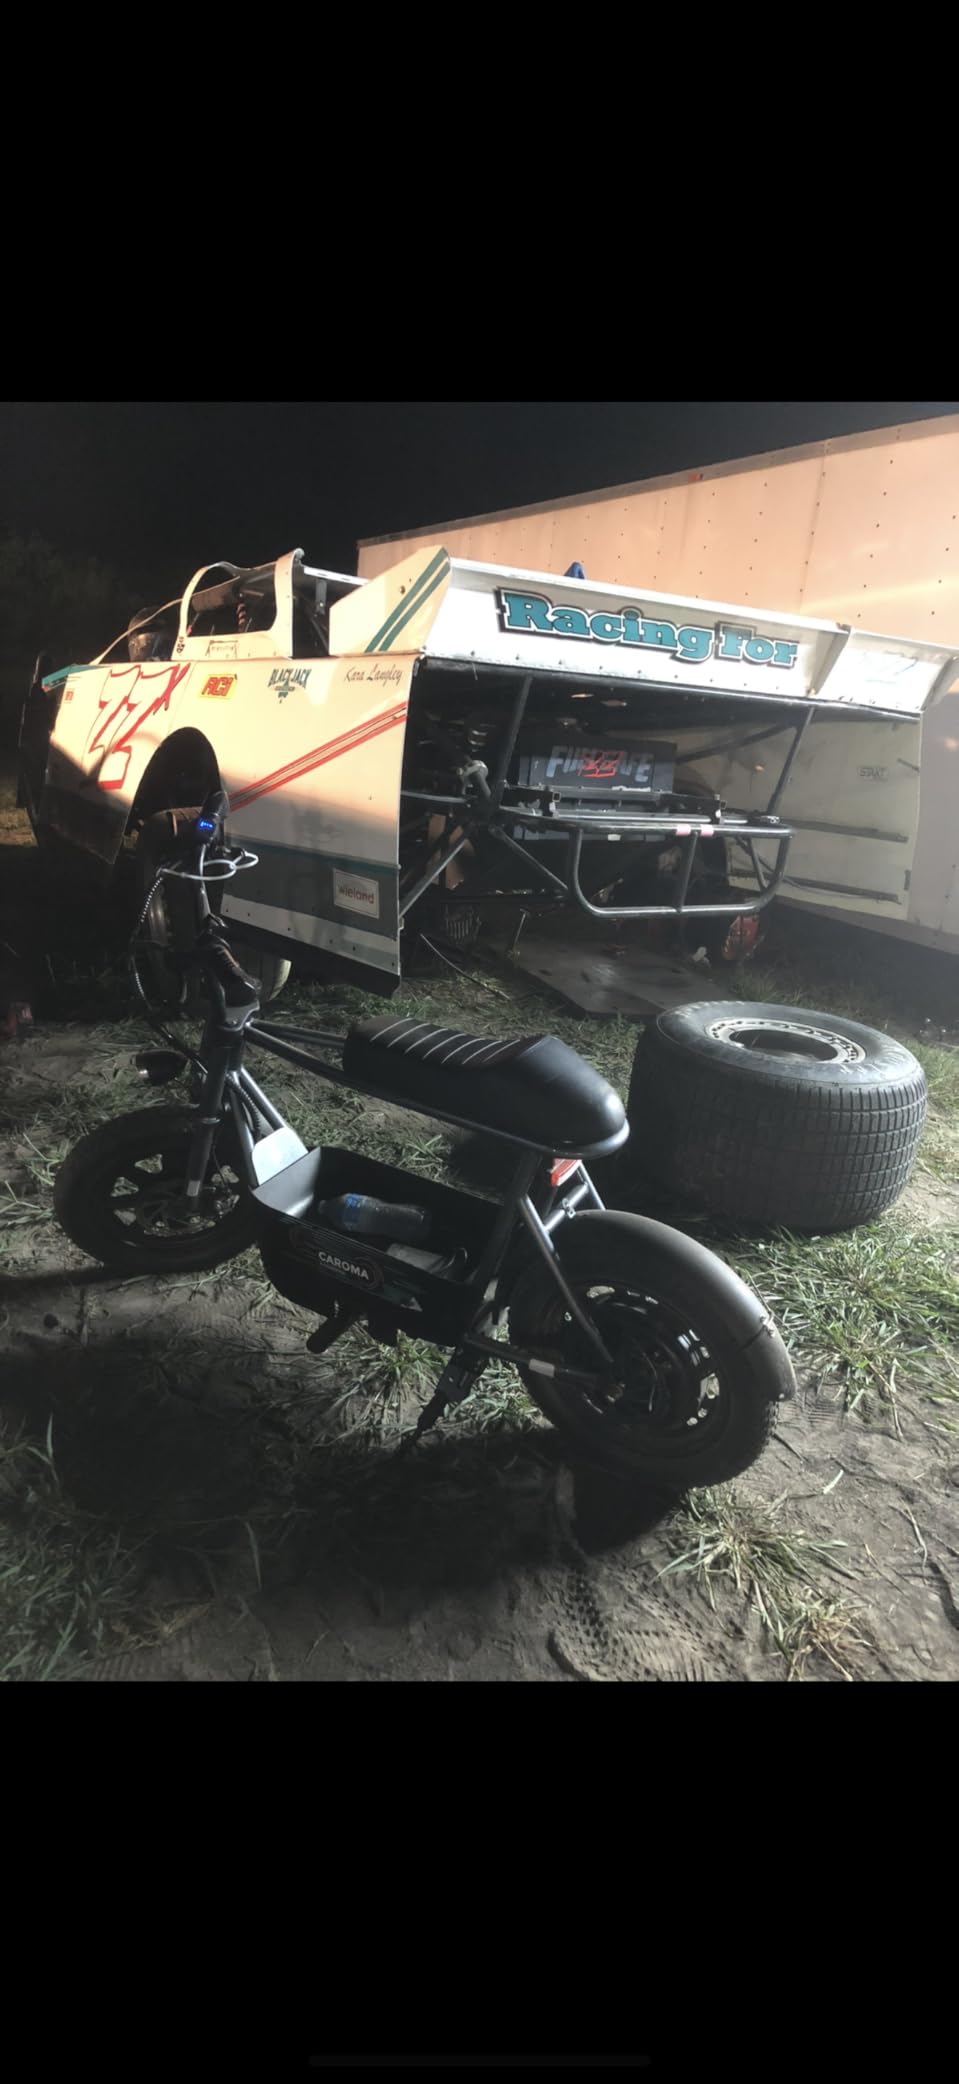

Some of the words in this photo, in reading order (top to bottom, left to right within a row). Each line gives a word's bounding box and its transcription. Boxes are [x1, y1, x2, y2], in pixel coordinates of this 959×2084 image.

[495, 586, 716, 663] Racing
[714, 621, 798, 669] For
[318, 1252, 369, 1280] CAROMA
